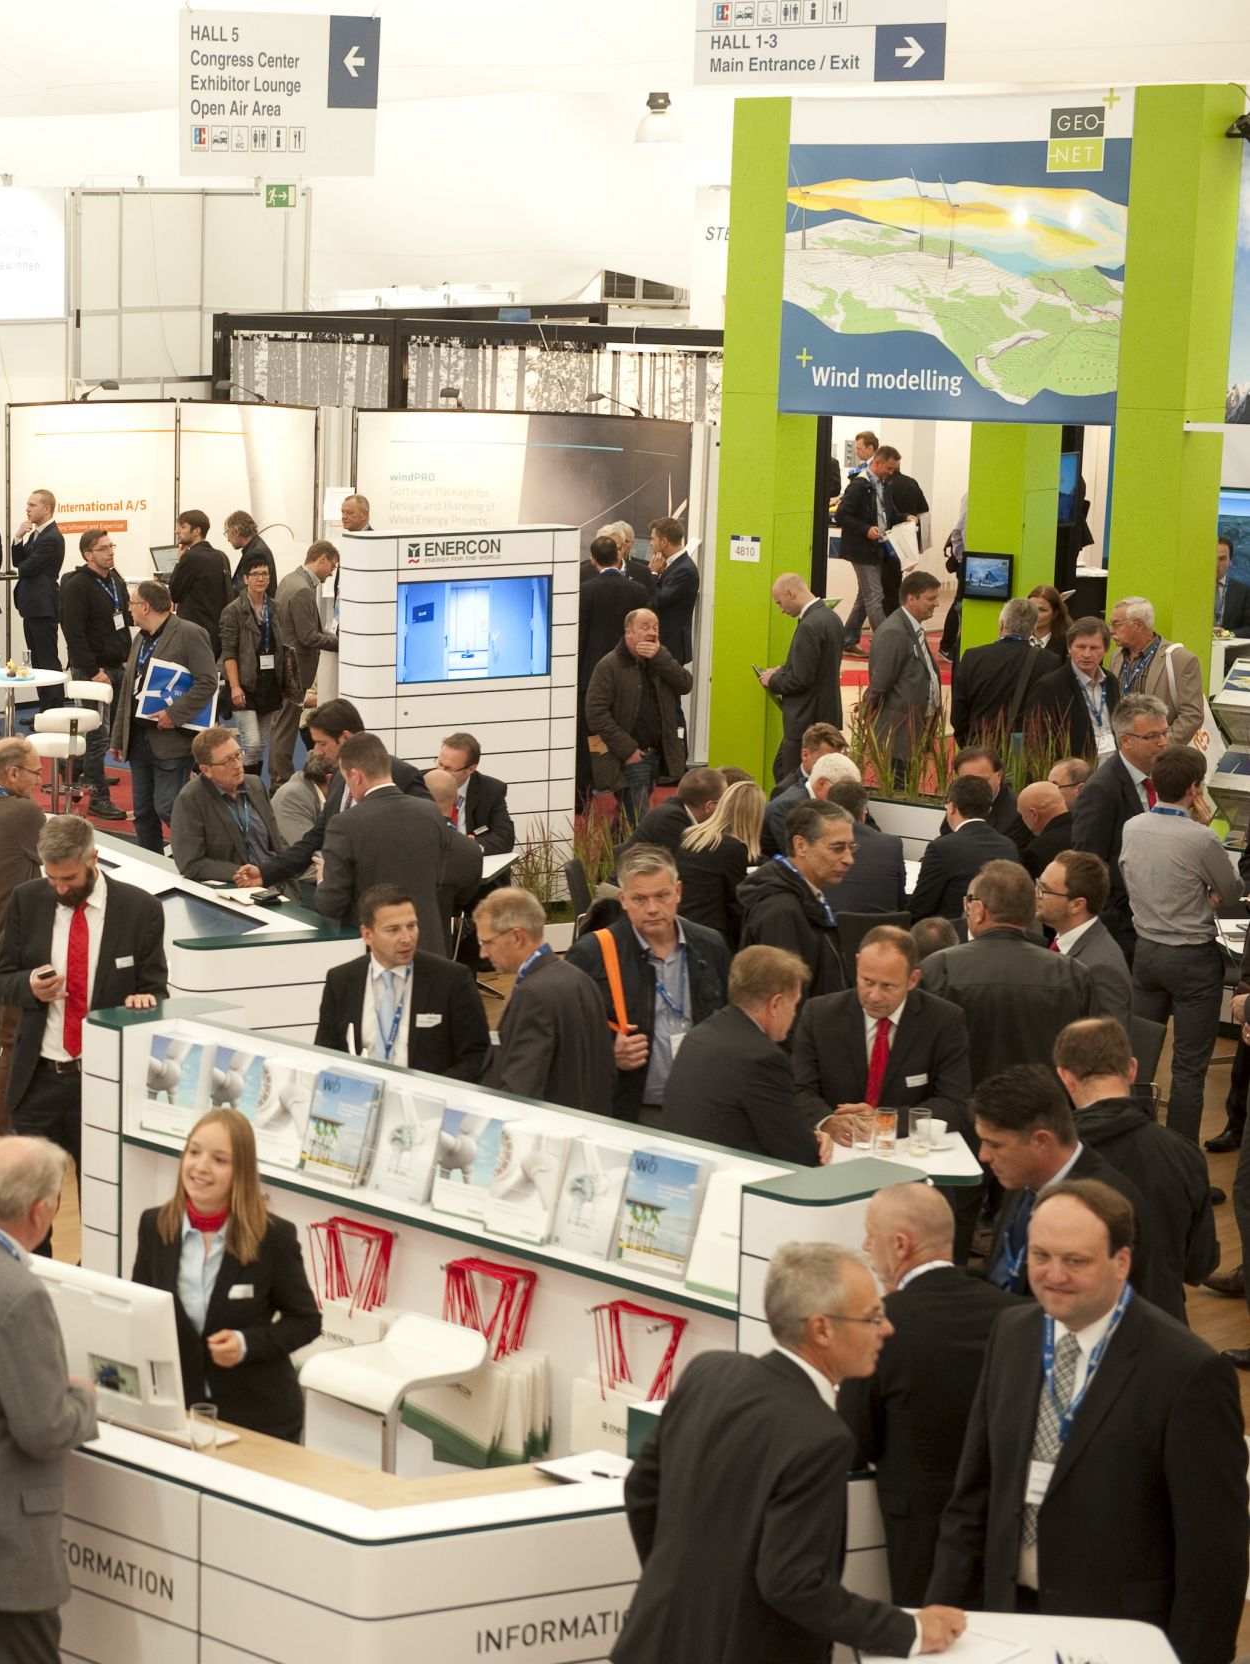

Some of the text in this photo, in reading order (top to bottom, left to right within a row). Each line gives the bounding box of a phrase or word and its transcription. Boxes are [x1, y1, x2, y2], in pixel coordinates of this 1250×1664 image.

[190, 25, 239, 42] HALL 5
[710, 34, 778, 50] HALL 1-3
[190, 49, 300, 71] Congress Center
[710, 57, 744, 73] Main
[749, 56, 816, 72] Entrance
[830, 54, 860, 71] Exit
[190, 74, 301, 97] Exhibitor Lounge
[190, 99, 281, 119] Open Air Area
[811, 366, 963, 397] Wind modelling
[390, 472, 436, 482] windPRO
[57, 499, 148, 514] International A/S
[425, 539, 501, 557] ENERCON
[735, 545, 755, 557] 4B10
